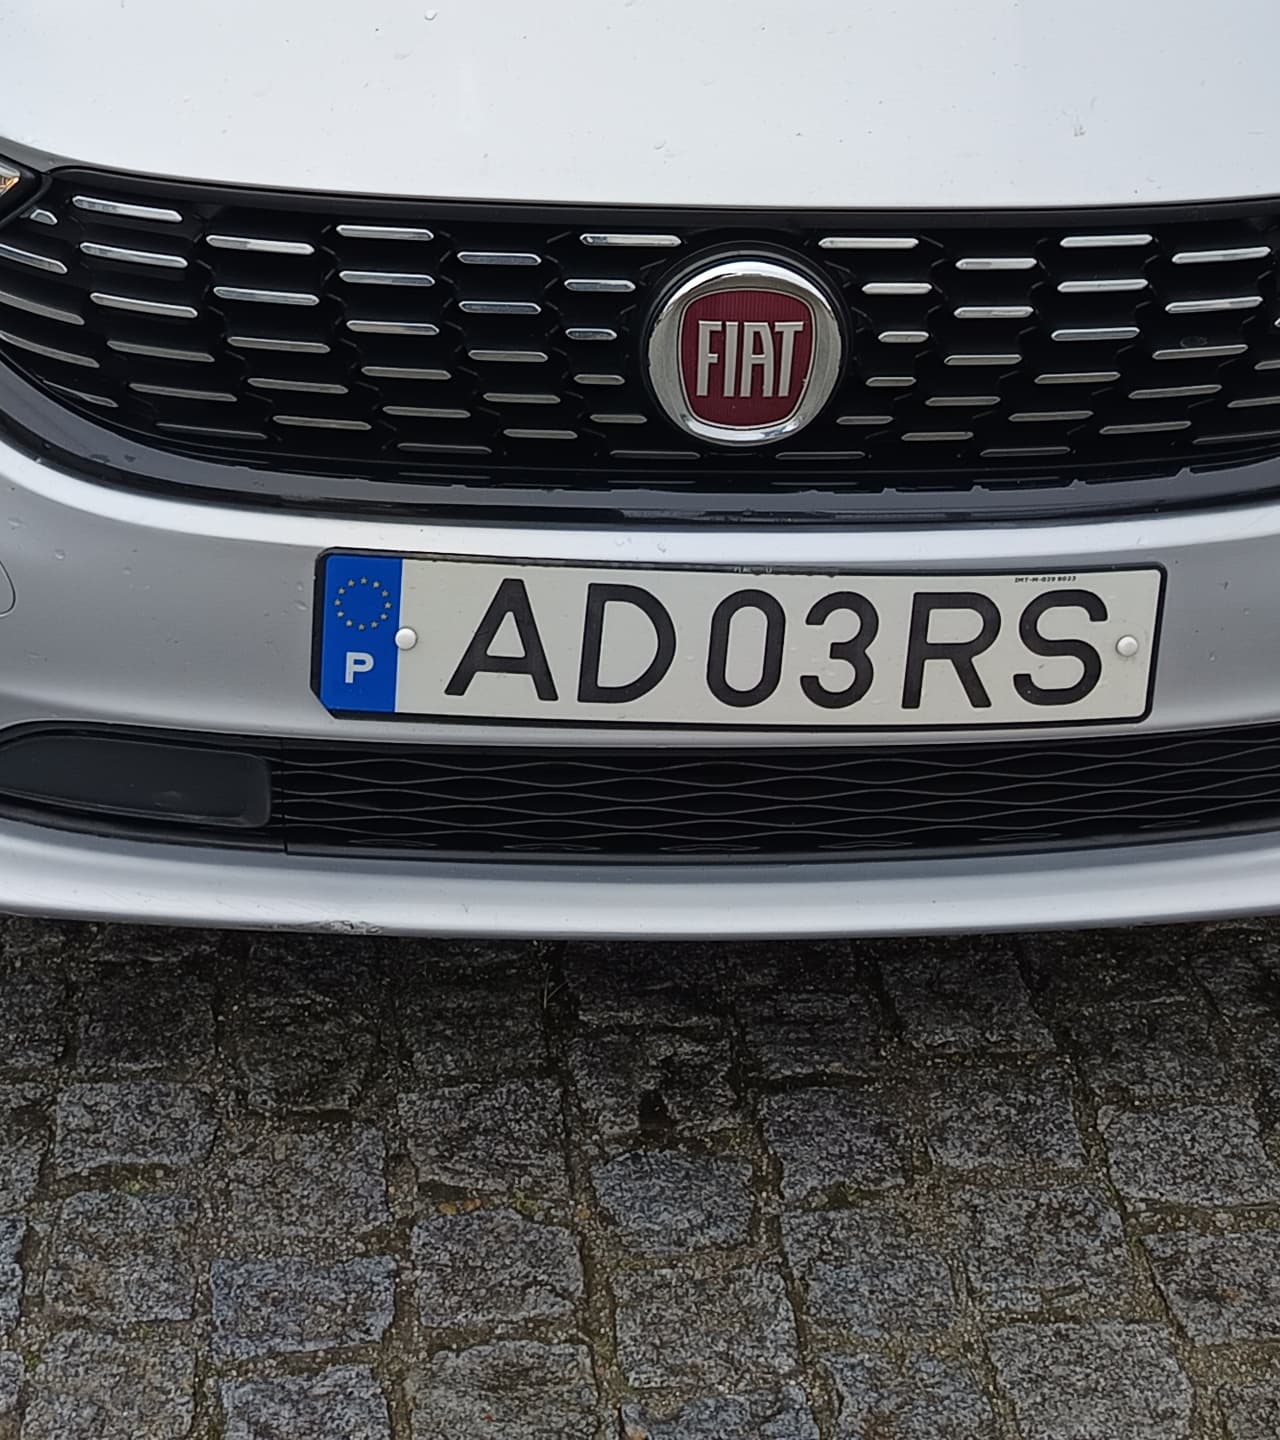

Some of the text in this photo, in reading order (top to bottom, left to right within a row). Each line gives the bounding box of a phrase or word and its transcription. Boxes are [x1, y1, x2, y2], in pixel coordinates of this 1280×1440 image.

[695, 320, 804, 397] FIAT
[344, 578, 1108, 709] P AD03RS
